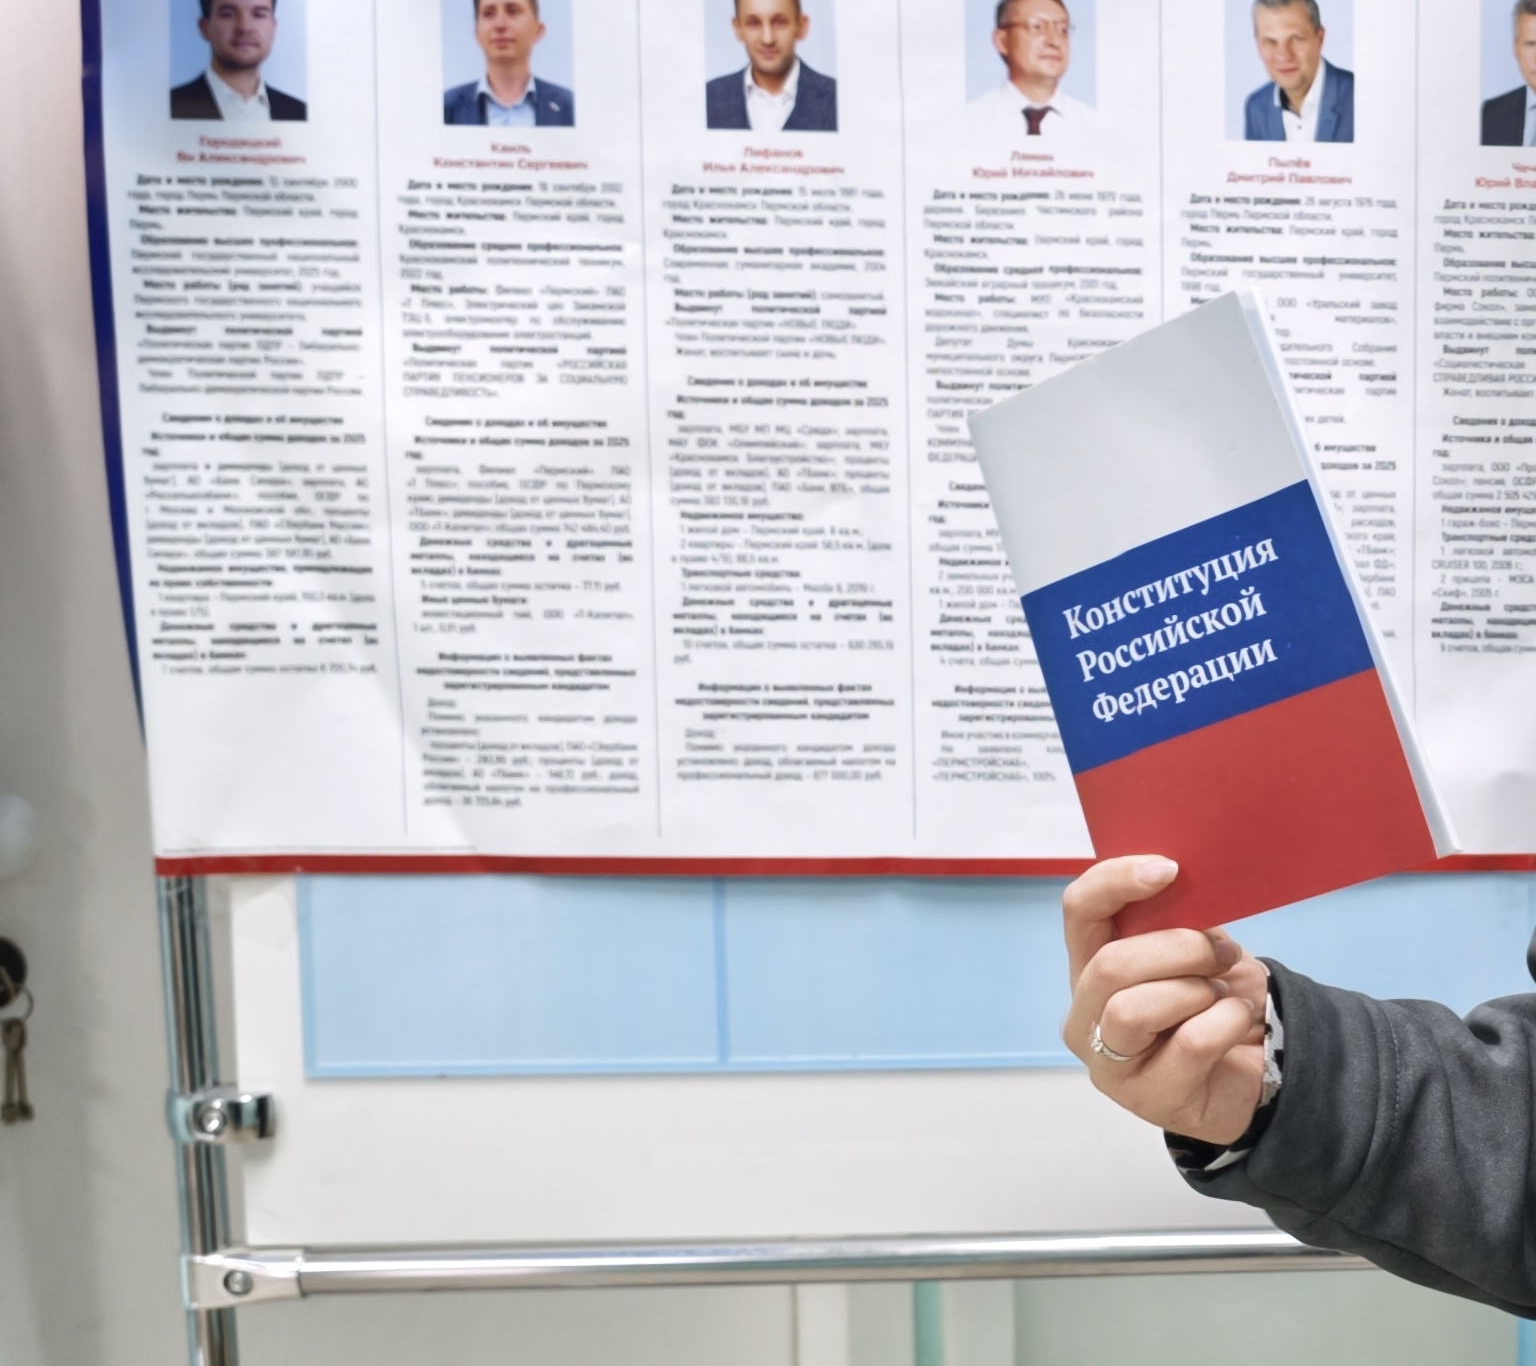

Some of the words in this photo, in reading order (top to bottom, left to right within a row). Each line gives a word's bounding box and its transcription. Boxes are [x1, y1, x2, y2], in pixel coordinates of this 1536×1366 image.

[1063, 538, 1279, 639] Конституция
[1076, 586, 1268, 683] Российской
[1093, 638, 1279, 724] Федерации
